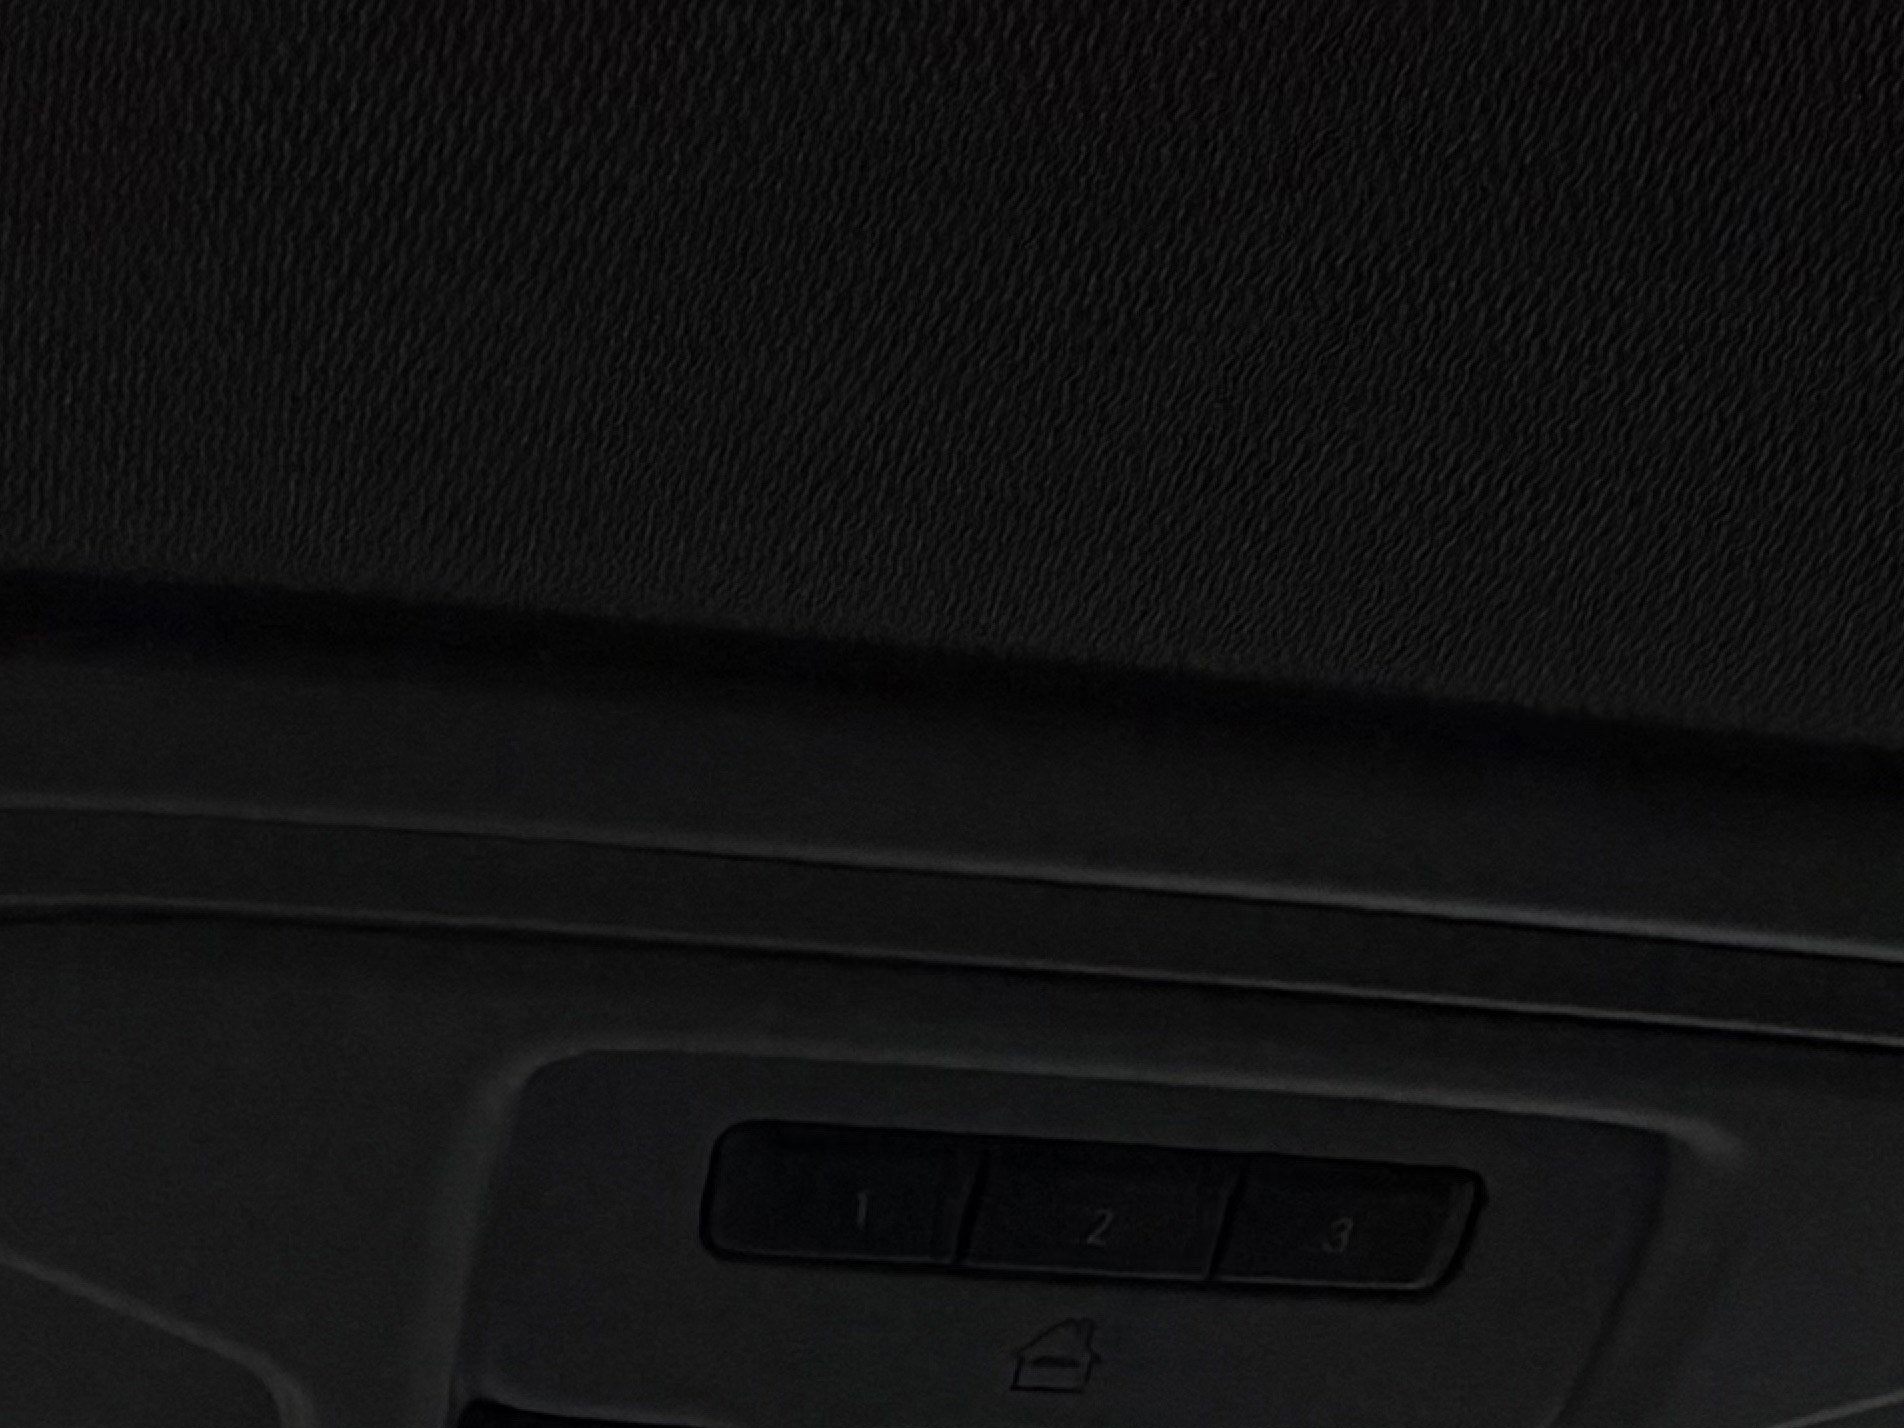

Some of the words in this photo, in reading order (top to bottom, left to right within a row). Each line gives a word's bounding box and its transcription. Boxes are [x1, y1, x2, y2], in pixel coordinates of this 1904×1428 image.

[852, 1190, 871, 1229] 1
[1084, 1209, 1115, 1246] 2
[1321, 1216, 1355, 1254] 3
